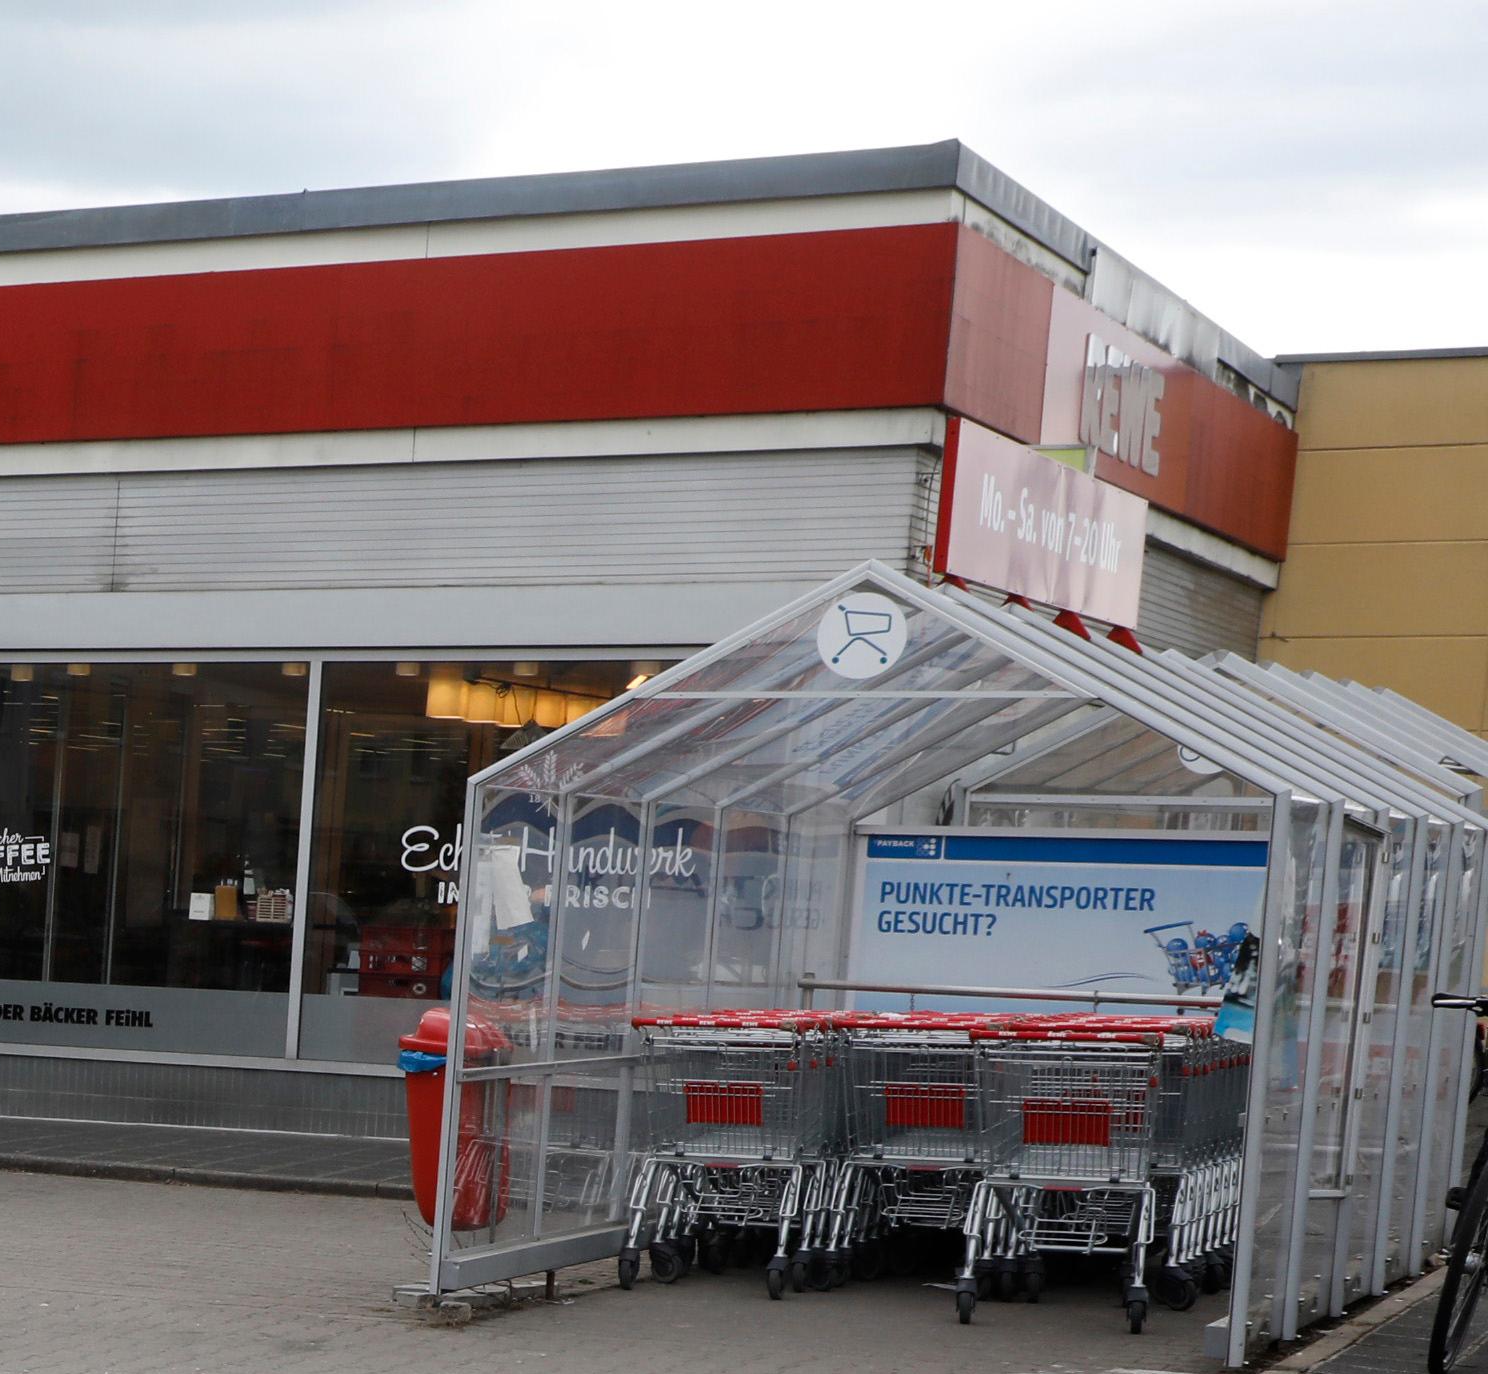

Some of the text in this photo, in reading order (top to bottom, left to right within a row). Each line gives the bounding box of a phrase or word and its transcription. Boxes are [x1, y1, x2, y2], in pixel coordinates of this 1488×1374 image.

[1078, 332, 1165, 477] REWE
[1041, 509, 1065, 554] von
[1100, 520, 1123, 575] Uhr
[875, 838, 915, 849] PAYBACK
[879, 880, 1156, 912] PUNKTE-TRANSPORTER
[877, 909, 998, 937] GESUCHT?
[29, 1002, 99, 1026] BÄCKER
